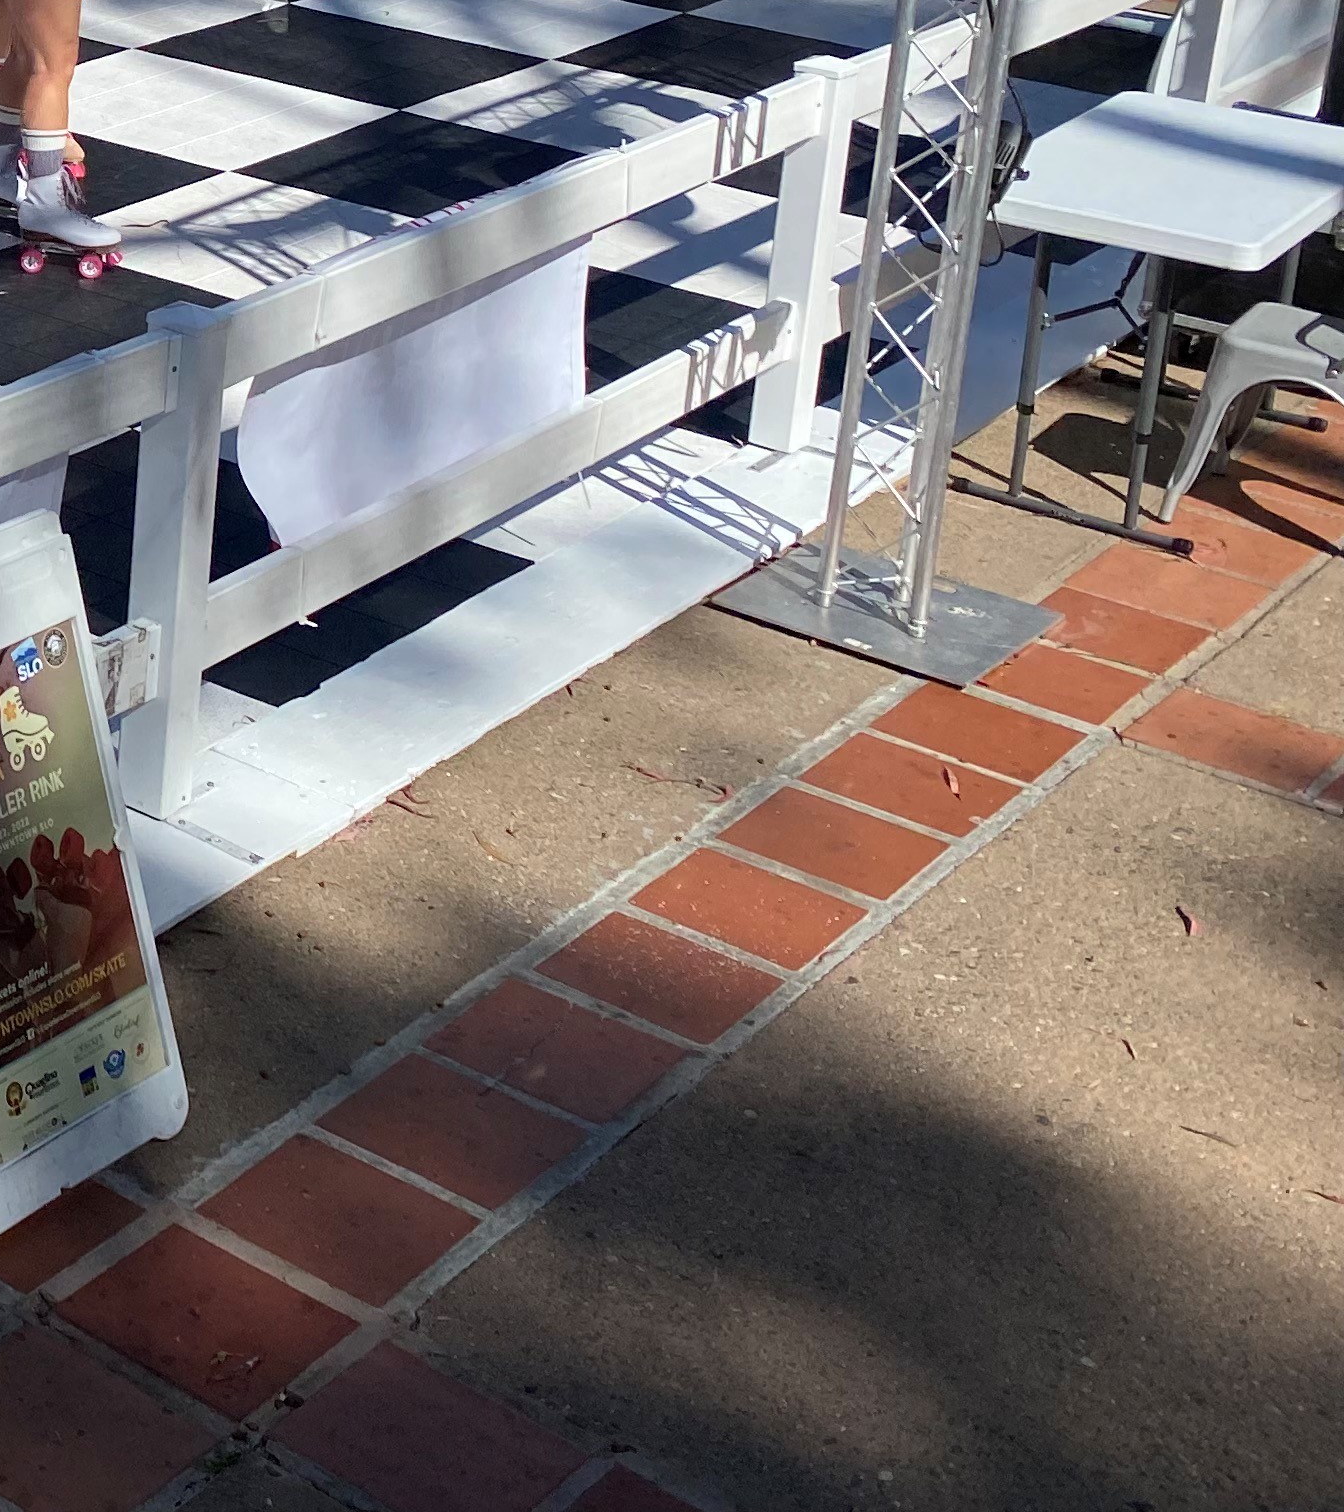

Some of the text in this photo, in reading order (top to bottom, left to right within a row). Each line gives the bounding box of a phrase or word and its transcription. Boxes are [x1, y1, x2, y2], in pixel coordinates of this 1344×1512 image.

[17, 657, 44, 682] SLO
[28, 767, 65, 803] RINK
[12, 816, 30, 832] 2022
[39, 818, 54, 833] SLO
[17, 961, 50, 987] online!
